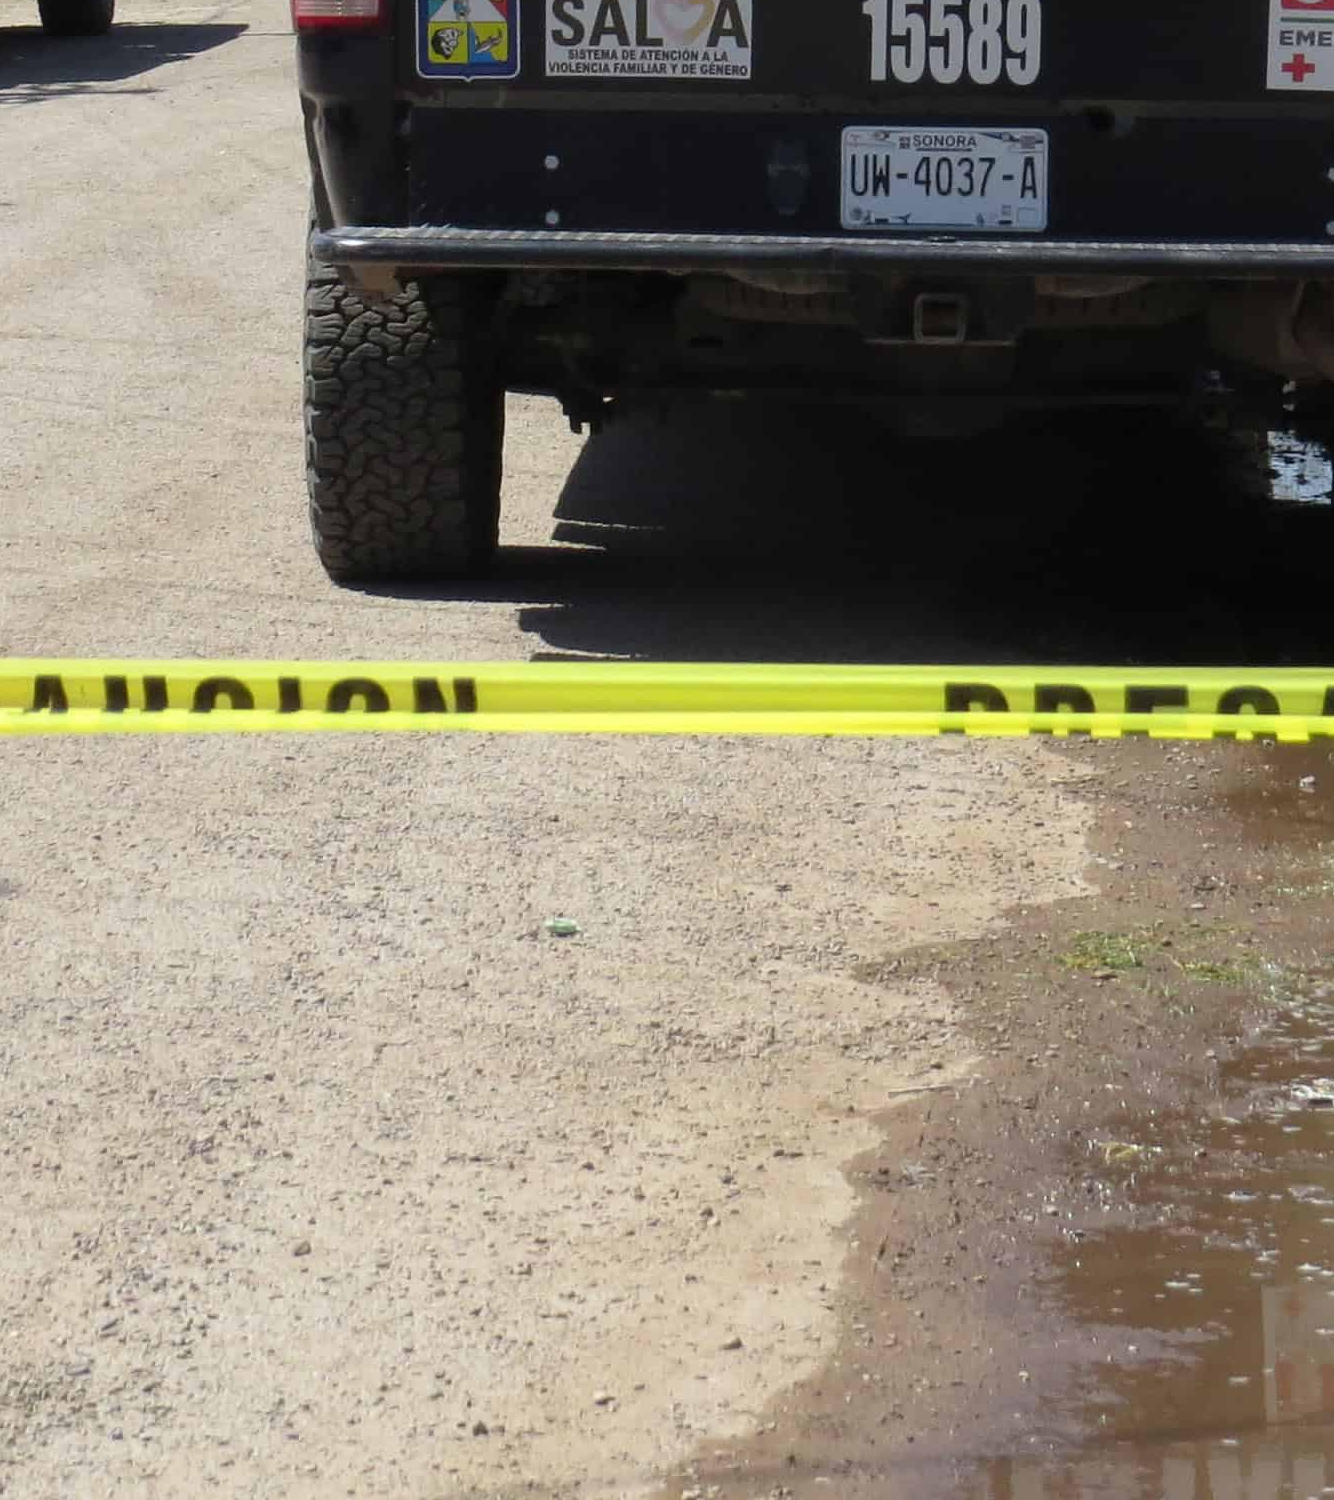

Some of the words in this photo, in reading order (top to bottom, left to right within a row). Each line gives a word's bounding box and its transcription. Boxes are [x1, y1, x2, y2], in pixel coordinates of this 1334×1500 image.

[568, 49, 617, 61] SISTEMA
[622, 50, 636, 61] DE
[702, 50, 710, 62] A
[714, 50, 728, 62] LA
[549, 62, 610, 74] VIOLENCIA
[614, 62, 666, 75] FAMILIAR
[670, 63, 677, 75] Y
[682, 63, 696, 75] DE
[700, 63, 748, 76] GÉNERO
[913, 135, 978, 148] SONORA
[850, 154, 1038, 199] UW-4037-A
